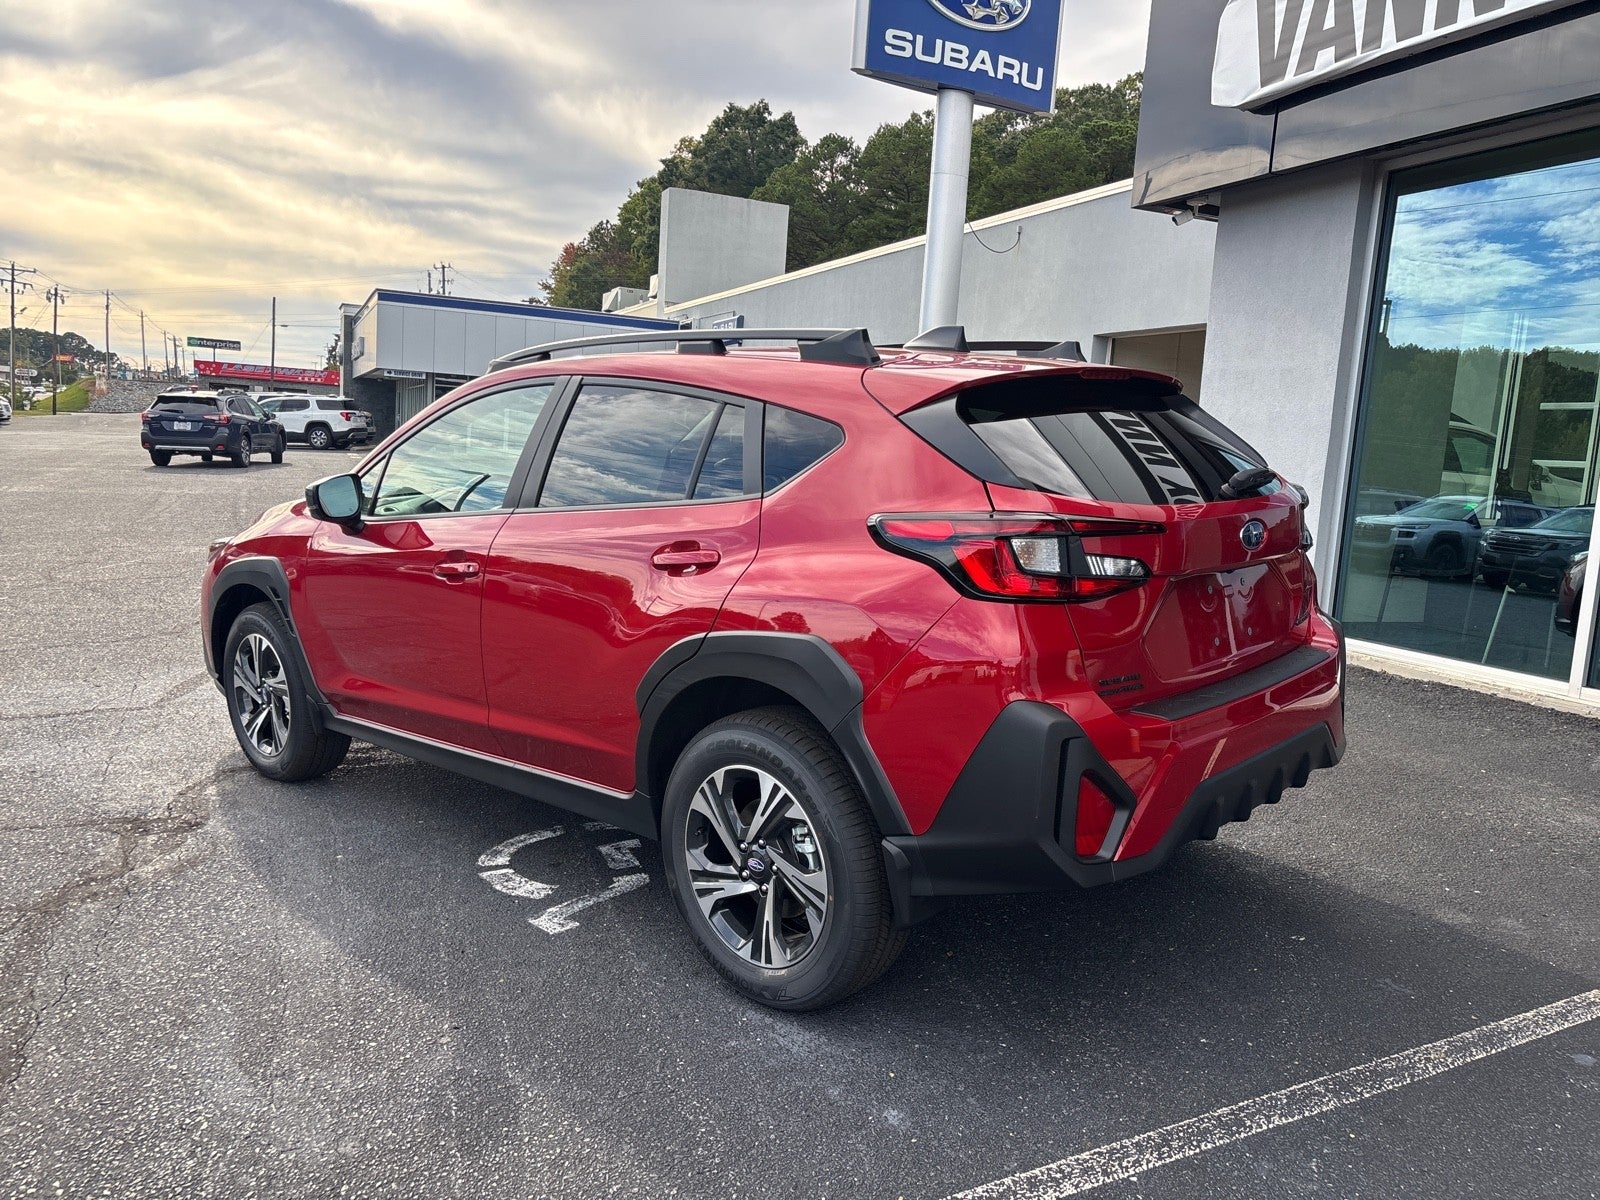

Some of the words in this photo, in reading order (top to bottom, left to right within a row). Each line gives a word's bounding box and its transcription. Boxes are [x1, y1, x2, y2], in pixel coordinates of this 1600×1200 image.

[884, 28, 1043, 91] SUBARU
[1257, 0, 1505, 88] VAN
[189, 338, 240, 349] enterprise
